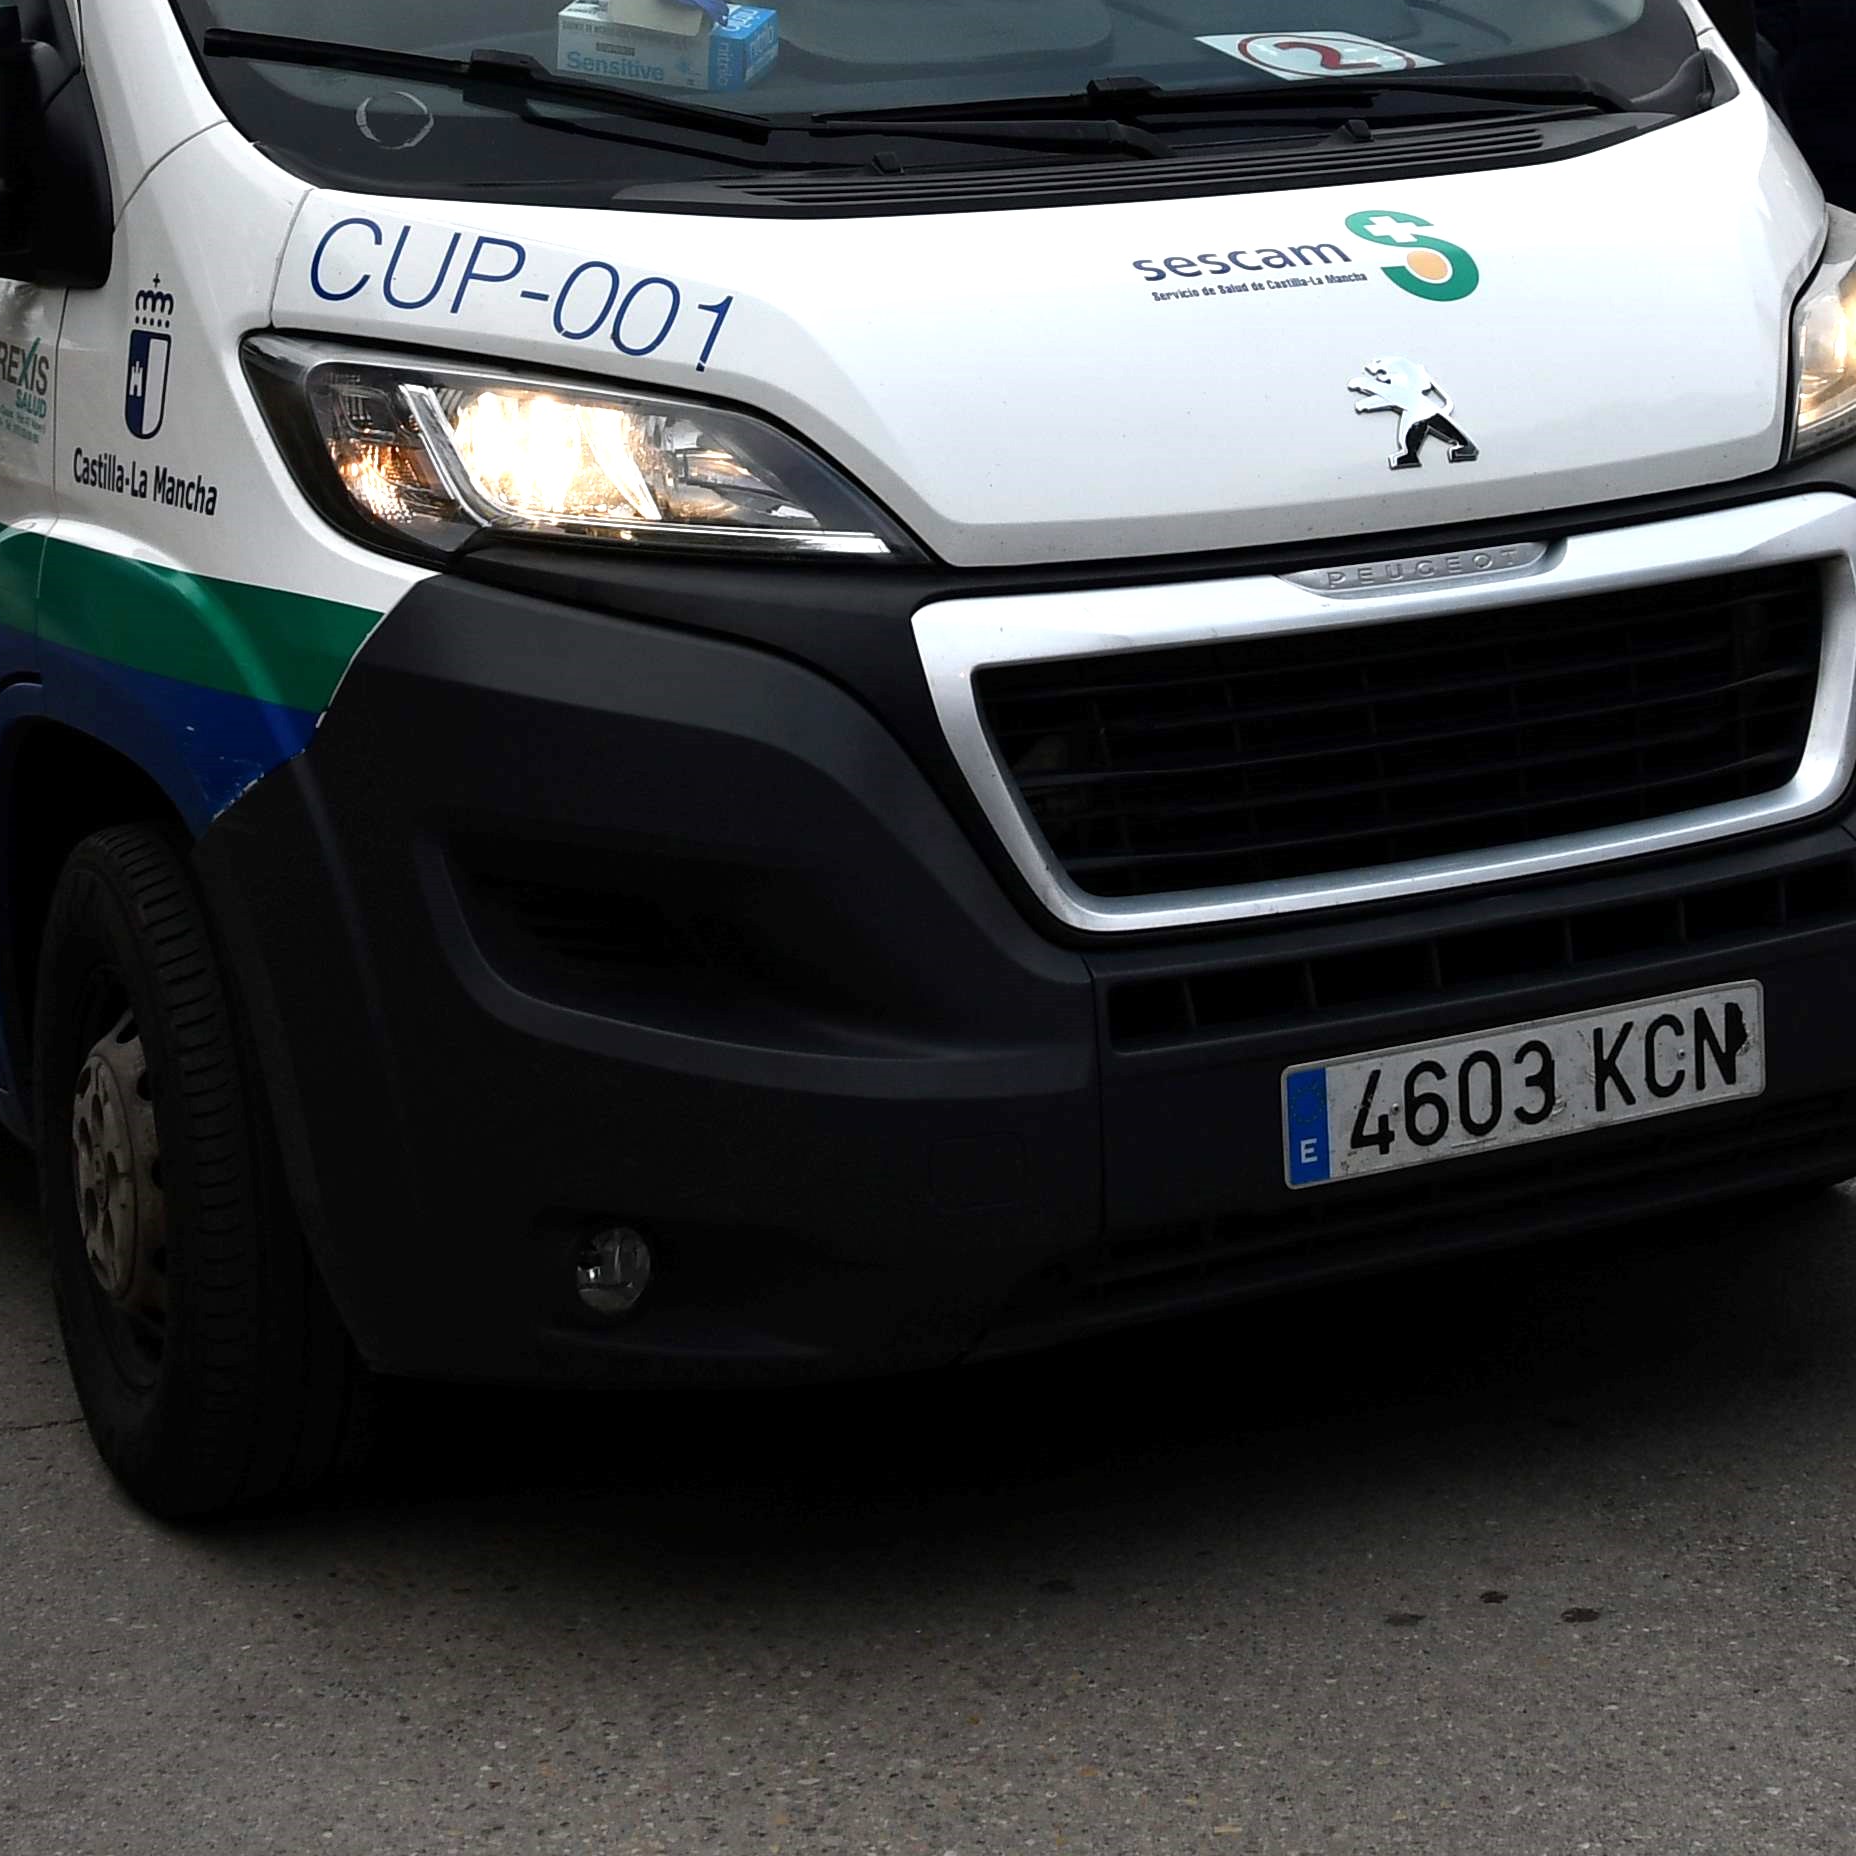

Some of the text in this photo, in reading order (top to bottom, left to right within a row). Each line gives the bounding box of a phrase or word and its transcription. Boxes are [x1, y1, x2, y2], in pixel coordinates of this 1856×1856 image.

[566, 50, 665, 82] Sensitive
[1273, 40, 1382, 70] 2
[1132, 243, 1352, 282] sescam
[310, 217, 734, 373] CUP-001
[1152, 272, 1368, 302] Servicio de Salud de Castilla-La Mancha
[74, 447, 218, 516] Castilla-La Mancha
[1326, 548, 1519, 589] PEUGEOT
[1349, 1001, 1749, 1156] 4603 KCN
[1299, 1137, 1318, 1164] E
